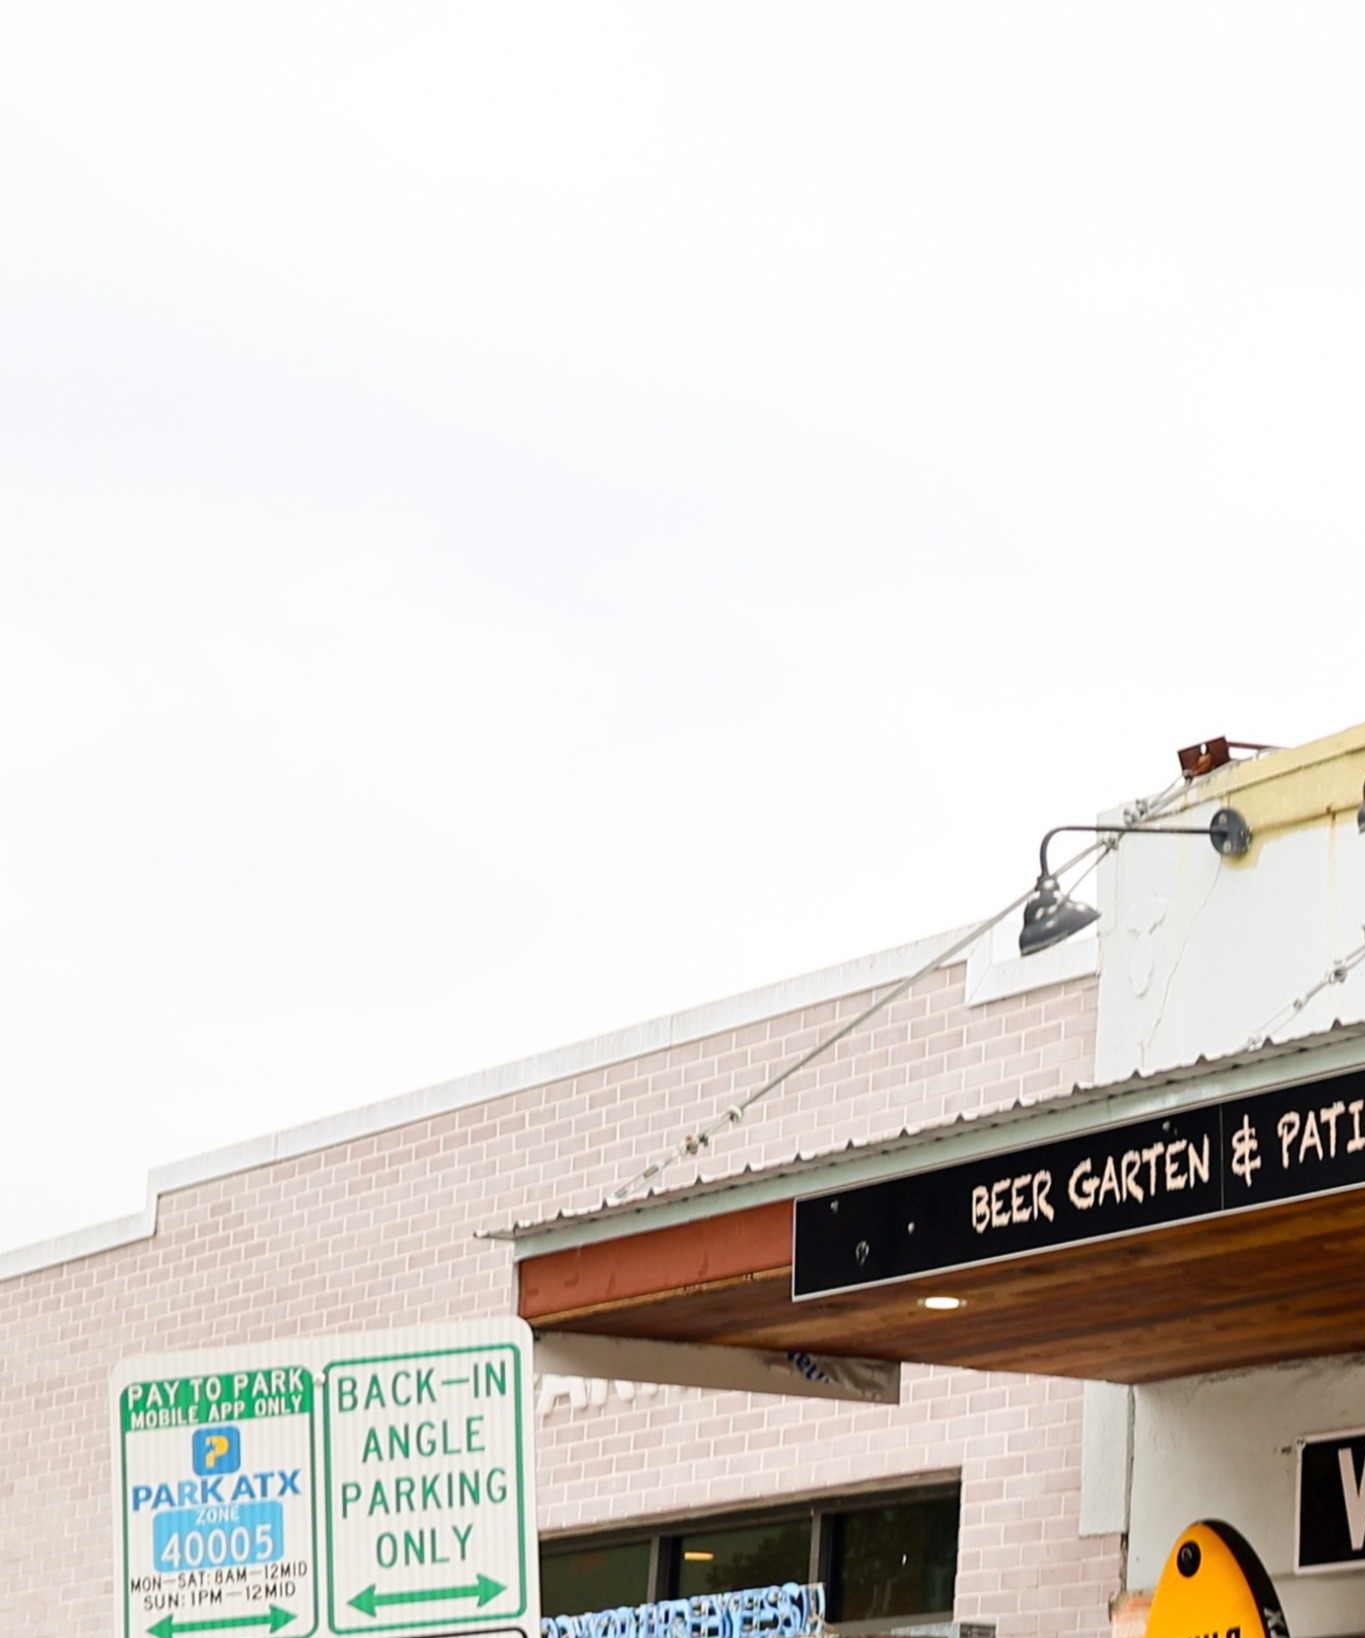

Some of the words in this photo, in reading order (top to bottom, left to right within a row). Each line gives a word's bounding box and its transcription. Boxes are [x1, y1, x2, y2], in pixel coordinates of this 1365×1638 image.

[971, 1170, 1055, 1234] BEER
[1067, 1134, 1210, 1210] GARTEN
[1231, 1114, 1262, 1187] &
[127, 1381, 181, 1411] PAY
[189, 1376, 222, 1403] TO
[233, 1368, 304, 1399] PARK
[338, 1359, 507, 1413] BACK-IN
[130, 1405, 200, 1430] MOBILE
[207, 1400, 246, 1422] APP
[254, 1395, 303, 1417] ONLY
[362, 1415, 486, 1464] ANGLE
[132, 1476, 225, 1511] PARK
[231, 1468, 302, 1500] ATX
[342, 1466, 508, 1519] PARKING
[196, 1505, 240, 1525] ZONE
[160, 1523, 275, 1569] 40005
[376, 1523, 473, 1568] ONLY
[143, 1595, 186, 1611] SUN:
